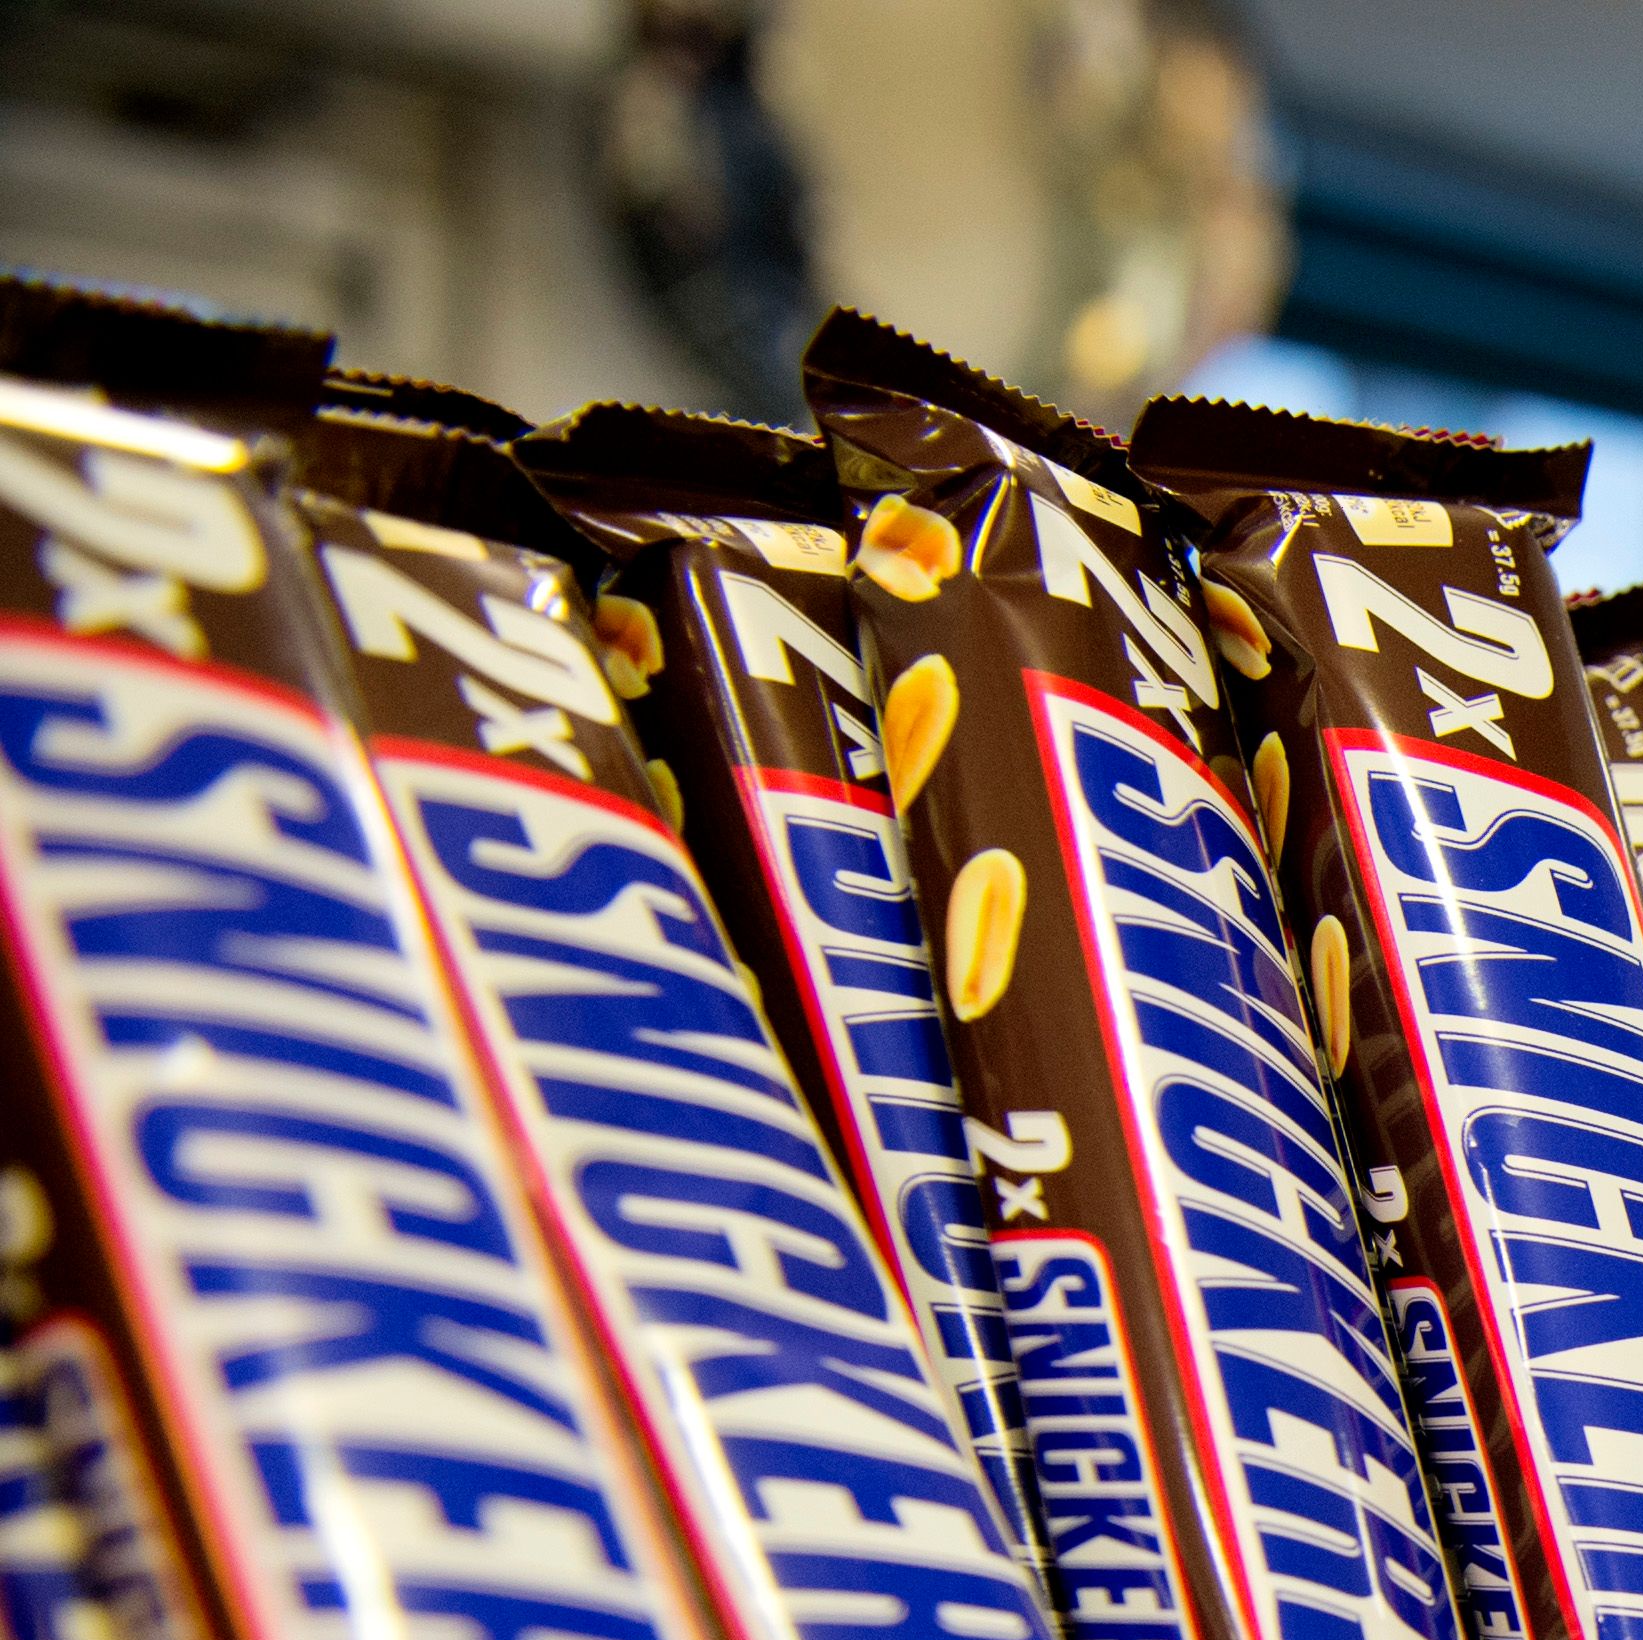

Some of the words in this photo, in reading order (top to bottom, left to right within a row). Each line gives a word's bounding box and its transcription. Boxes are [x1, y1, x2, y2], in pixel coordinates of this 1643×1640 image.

[318, 543, 622, 782] 2x
[1030, 492, 1218, 746] 2x
[1312, 552, 1554, 760] 2x
[1490, 543, 1523, 598] 37.5g
[965, 1112, 1073, 1222] 2x
